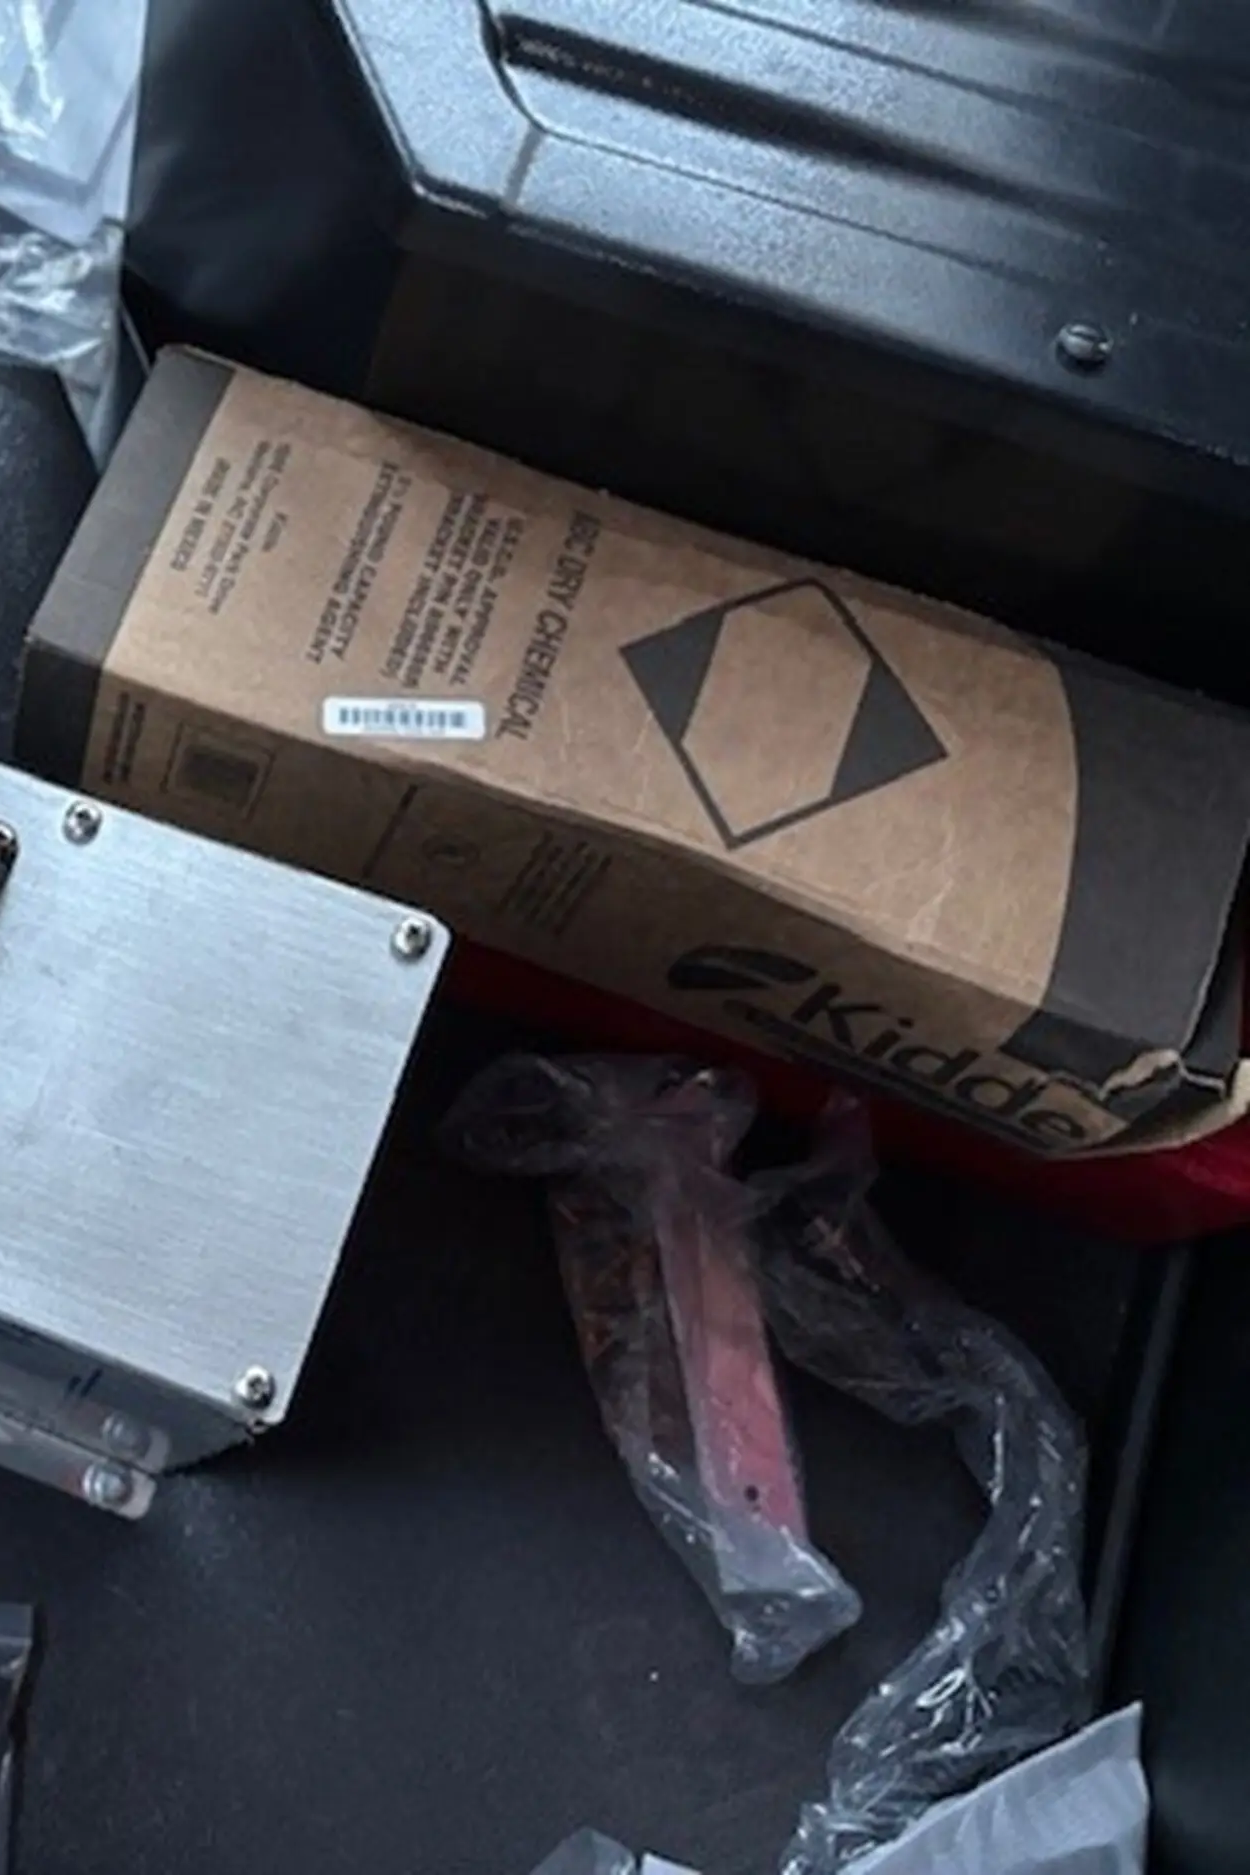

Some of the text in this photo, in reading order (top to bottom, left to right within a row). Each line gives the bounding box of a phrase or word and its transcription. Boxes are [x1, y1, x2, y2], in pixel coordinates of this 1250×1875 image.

[306, 597, 342, 665] AGENT
[330, 564, 378, 661] CAPACITY
[546, 553, 588, 612] DRY
[448, 586, 499, 686] APPROVAL
[493, 608, 568, 741] CHEMICAL
[790, 980, 1088, 1143] Kidde
